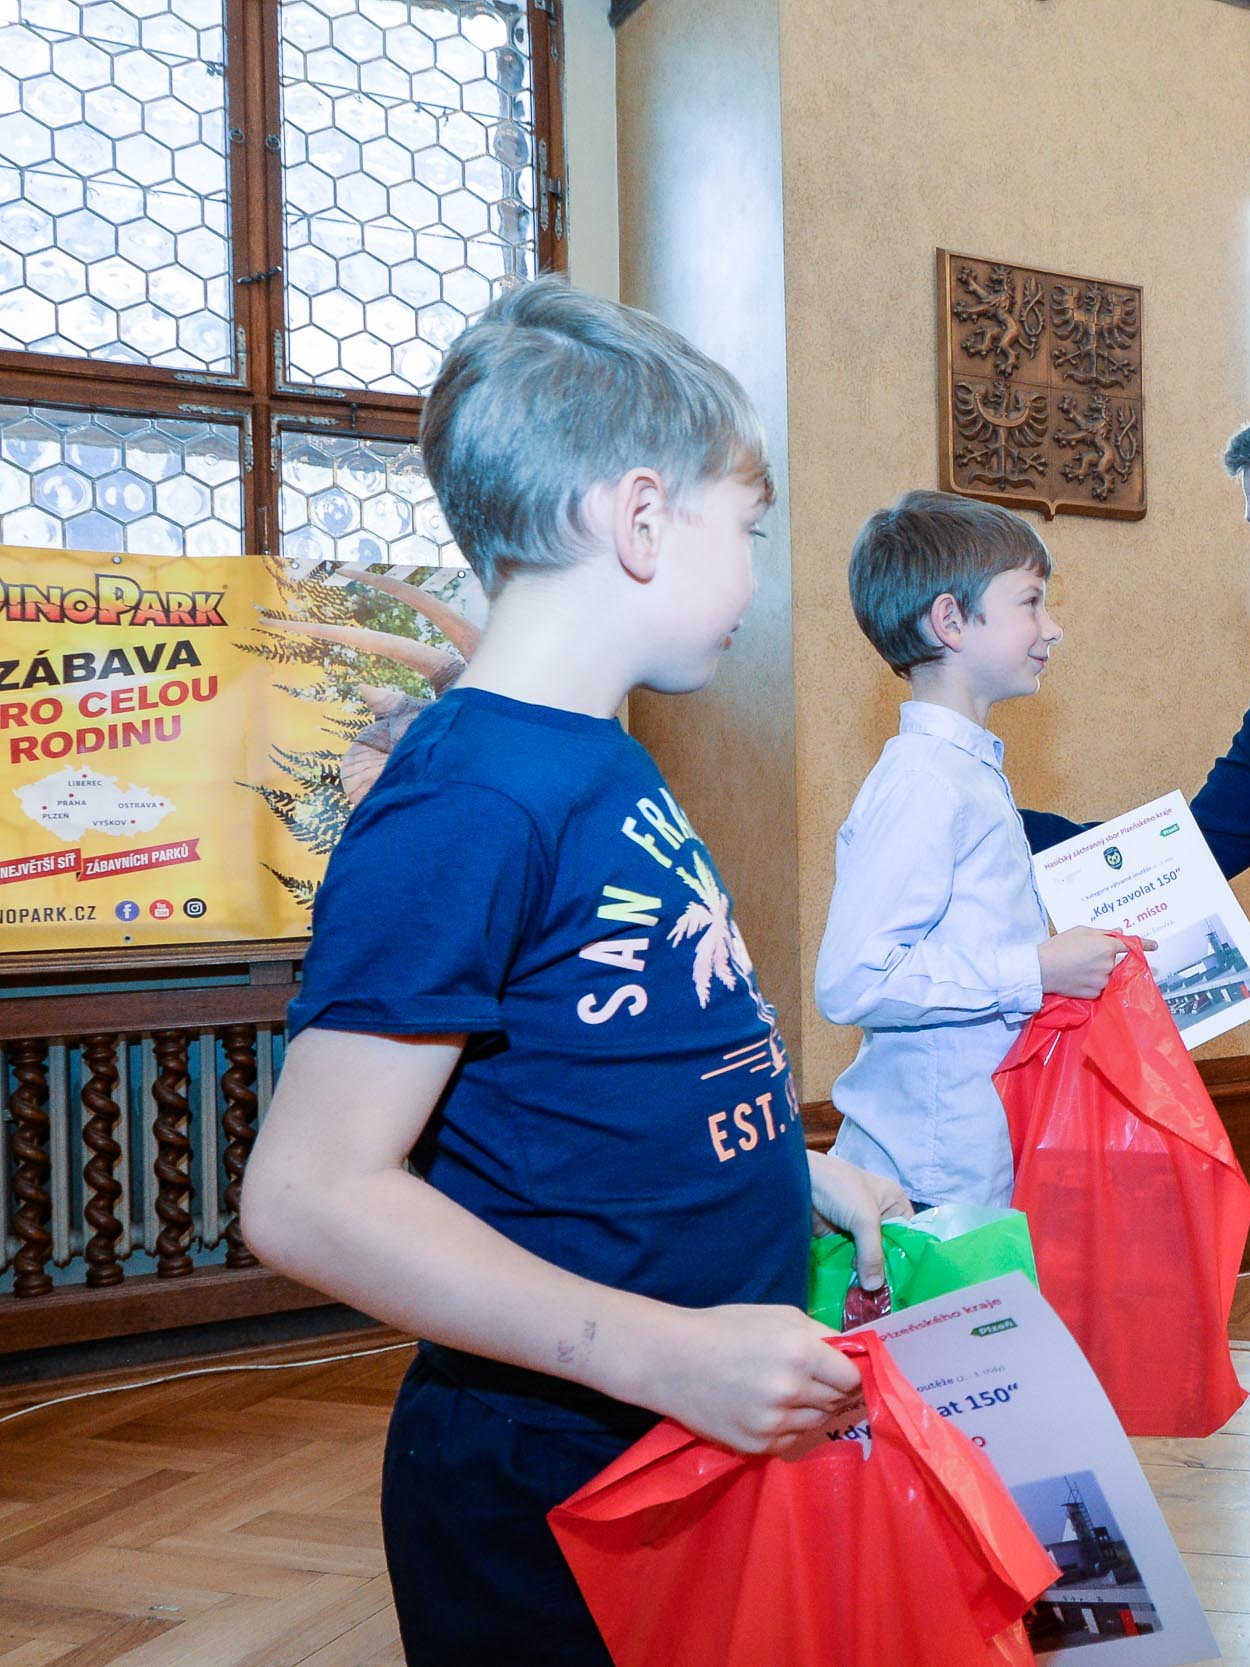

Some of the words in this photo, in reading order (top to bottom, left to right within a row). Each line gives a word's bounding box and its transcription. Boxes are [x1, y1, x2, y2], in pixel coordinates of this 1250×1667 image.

[0, 573, 228, 627] INOPARK
[0, 640, 202, 691] ZÁBAVA
[0, 697, 63, 729] RO
[78, 675, 218, 718] CELOU
[10, 715, 181, 764] RODINU
[42, 812, 70, 820] PLZEŇ
[0, 856, 54, 879] NEJVĚTŠÍ
[86, 853, 149, 875] ZÁBAVNÍCH
[152, 844, 189, 863] PARKŮ
[1116, 882, 1156, 907] zavolat
[1123, 918, 1136, 928] 2.
[1136, 902, 1168, 922] místo
[577, 885, 662, 1025] SAN
[708, 1092, 786, 1162] EST.
[962, 1298, 1002, 1314] kraje
[916, 1377, 954, 1392] outěže
